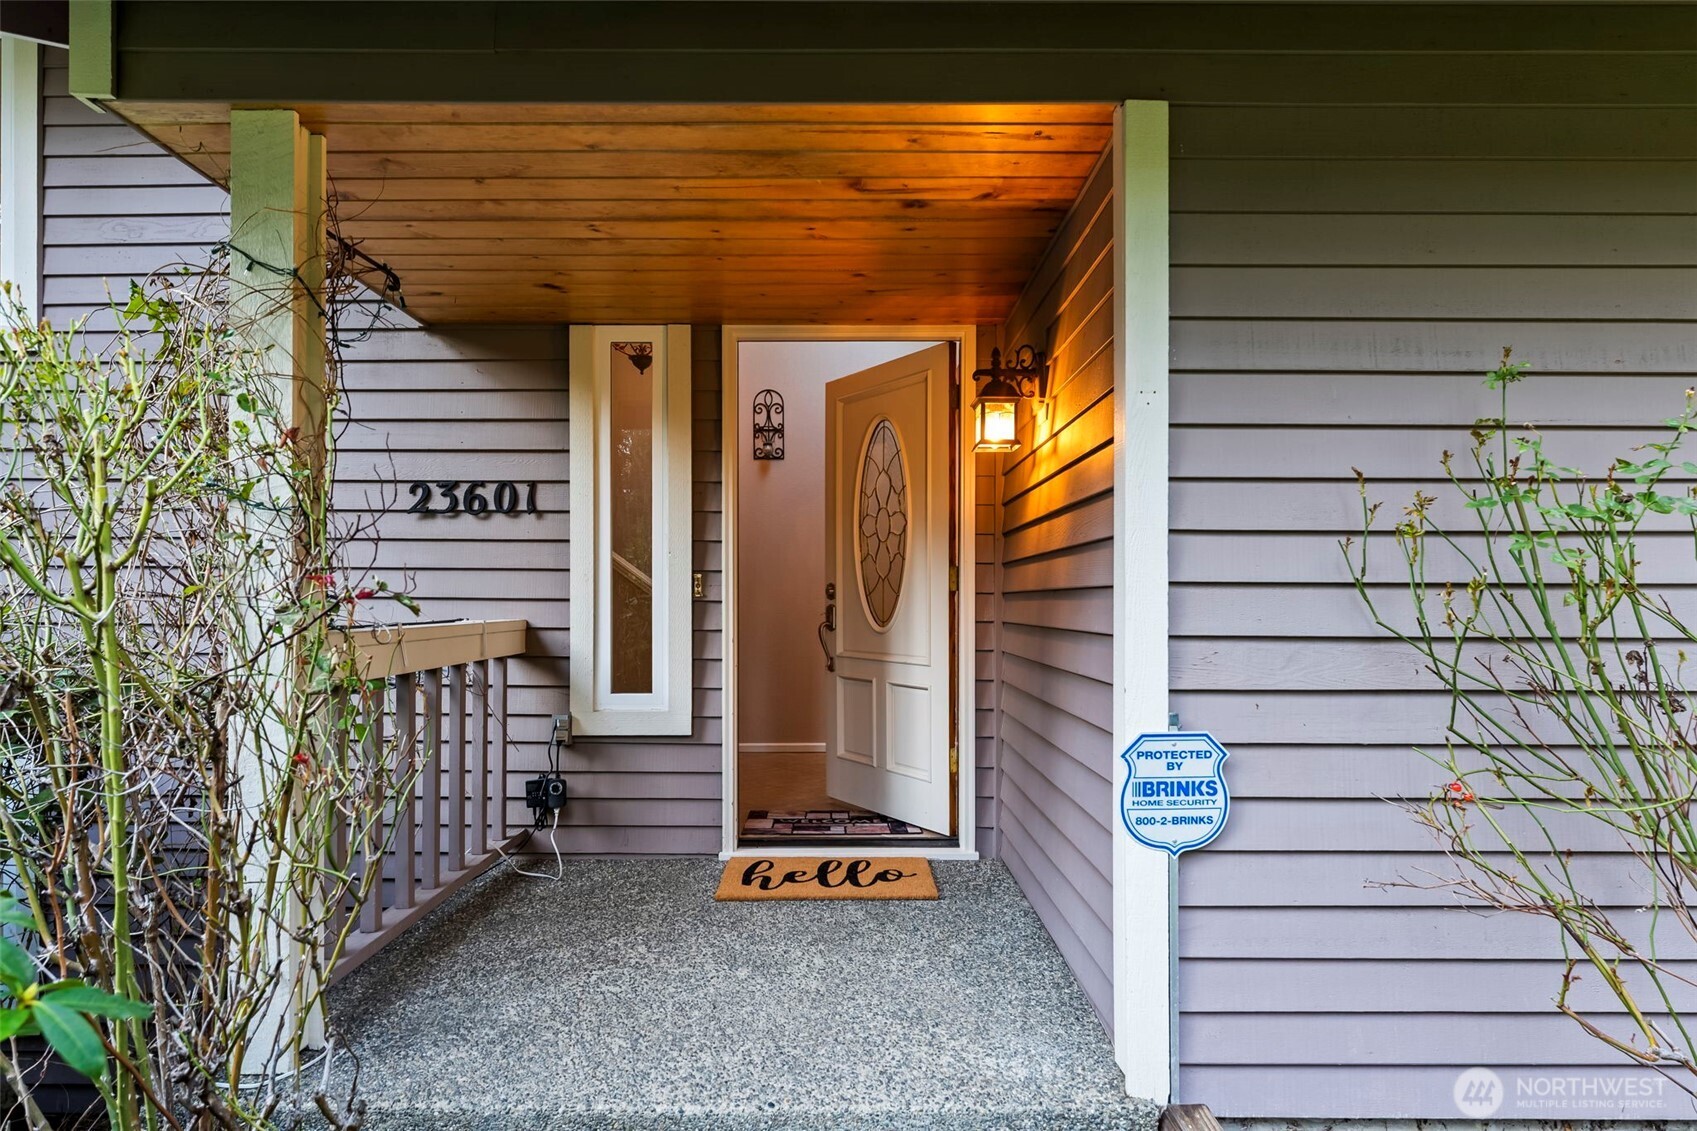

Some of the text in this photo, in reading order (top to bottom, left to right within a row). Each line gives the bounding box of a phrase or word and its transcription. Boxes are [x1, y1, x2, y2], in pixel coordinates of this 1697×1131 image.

[408, 481, 537, 515] 23601
[1136, 750, 1213, 760] PROTECTED
[1166, 762, 1183, 771] BY
[1142, 780, 1218, 797] BRINKS
[1132, 798, 1218, 807] HOME SECURITY
[1135, 816, 1214, 825] 800-2-BRINKS
[741, 860, 917, 890] hello
